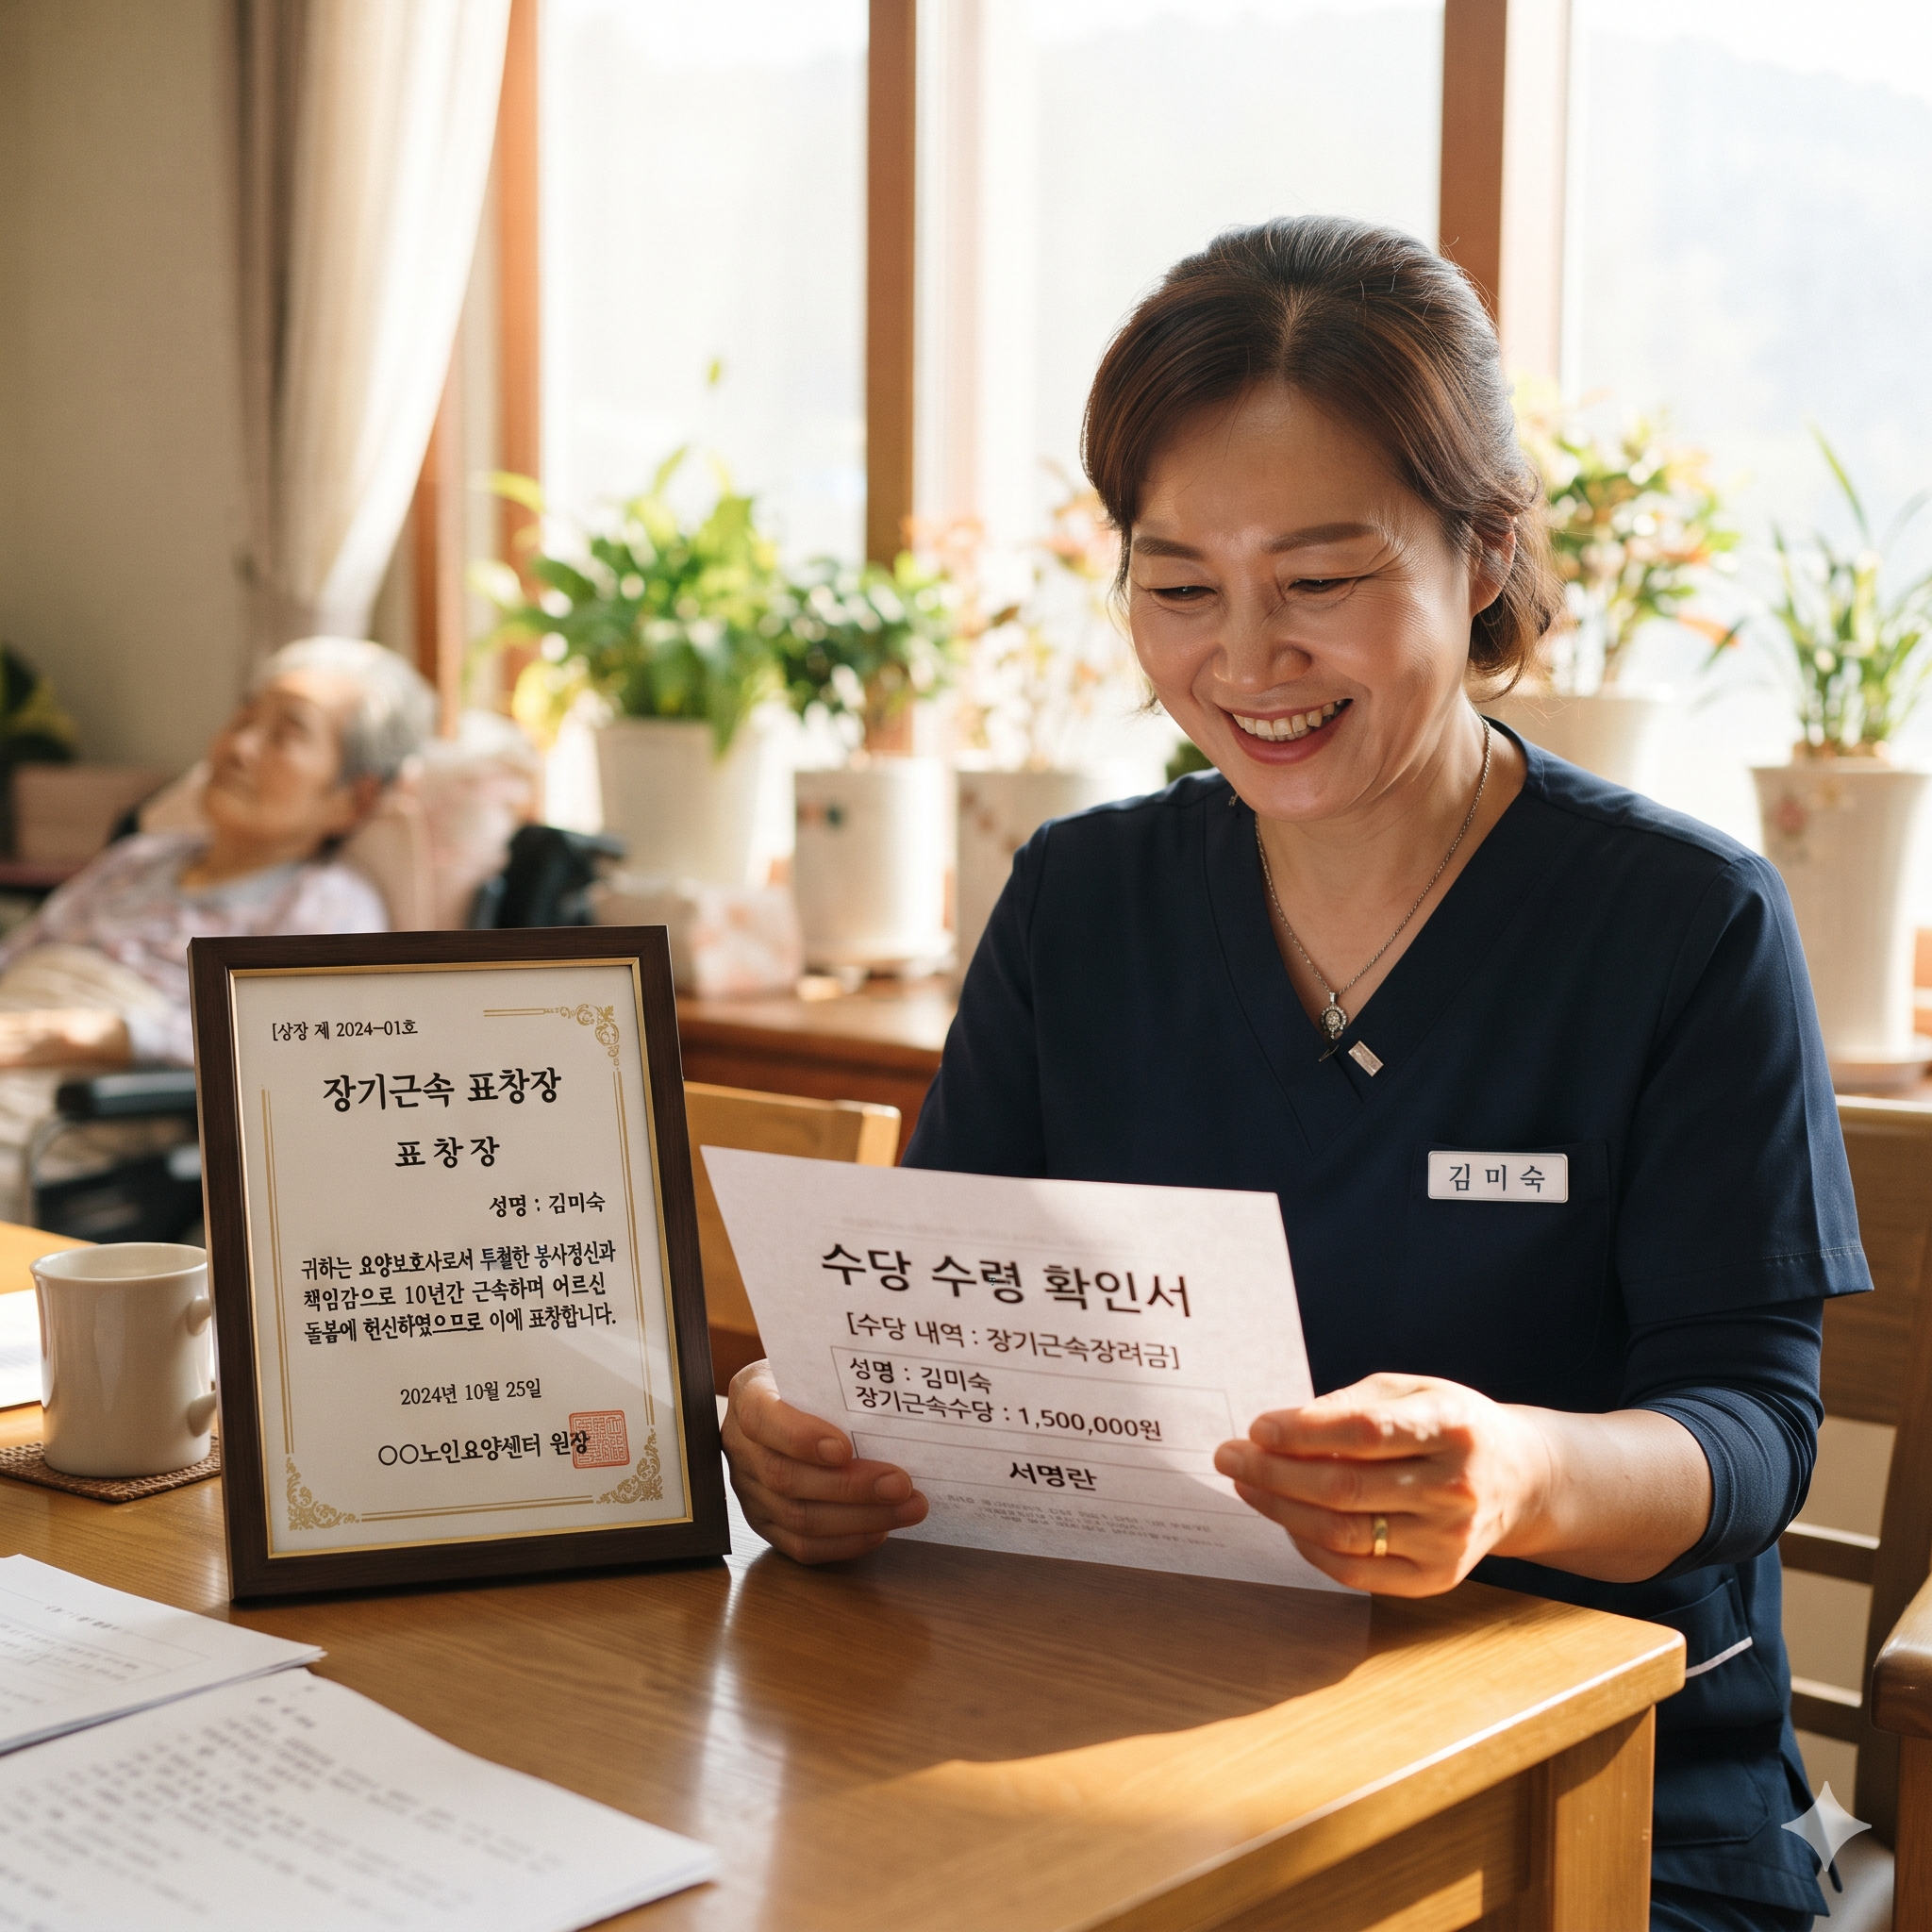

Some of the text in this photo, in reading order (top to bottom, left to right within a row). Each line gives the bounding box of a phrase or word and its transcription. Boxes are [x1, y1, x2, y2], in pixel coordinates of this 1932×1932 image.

[272, 1021, 309, 1041] [상장
[314, 1021, 330, 1041] 제
[323, 1066, 562, 1113] 장기근속 표창장
[489, 1193, 526, 1218] 성명
[548, 1191, 606, 1215] 김미숙
[300, 1239, 617, 1281] 귀하는 요양보호사로서 투철한 봉사정신과
[822, 1243, 1191, 1318] 수당 수령 확인서
[303, 1271, 607, 1312] 책임감으로 10년간 근속하며 어르신
[304, 1318, 358, 1345] 돌봄에
[489, 1307, 524, 1333] 이에
[528, 1301, 617, 1331] 표창합니다.
[846, 1311, 907, 1341] [수당
[914, 1321, 965, 1348] 내역
[986, 1327, 1179, 1370] 장기근속장려금]
[400, 1377, 542, 1406] 2024년 10월 25일
[849, 1357, 895, 1385] 성명
[920, 1366, 991, 1395] 김미숙
[855, 1386, 994, 1424] 장기근속수당
[1018, 1407, 1162, 1441] 1,500,000원
[1008, 1461, 1097, 1491] 서명란
